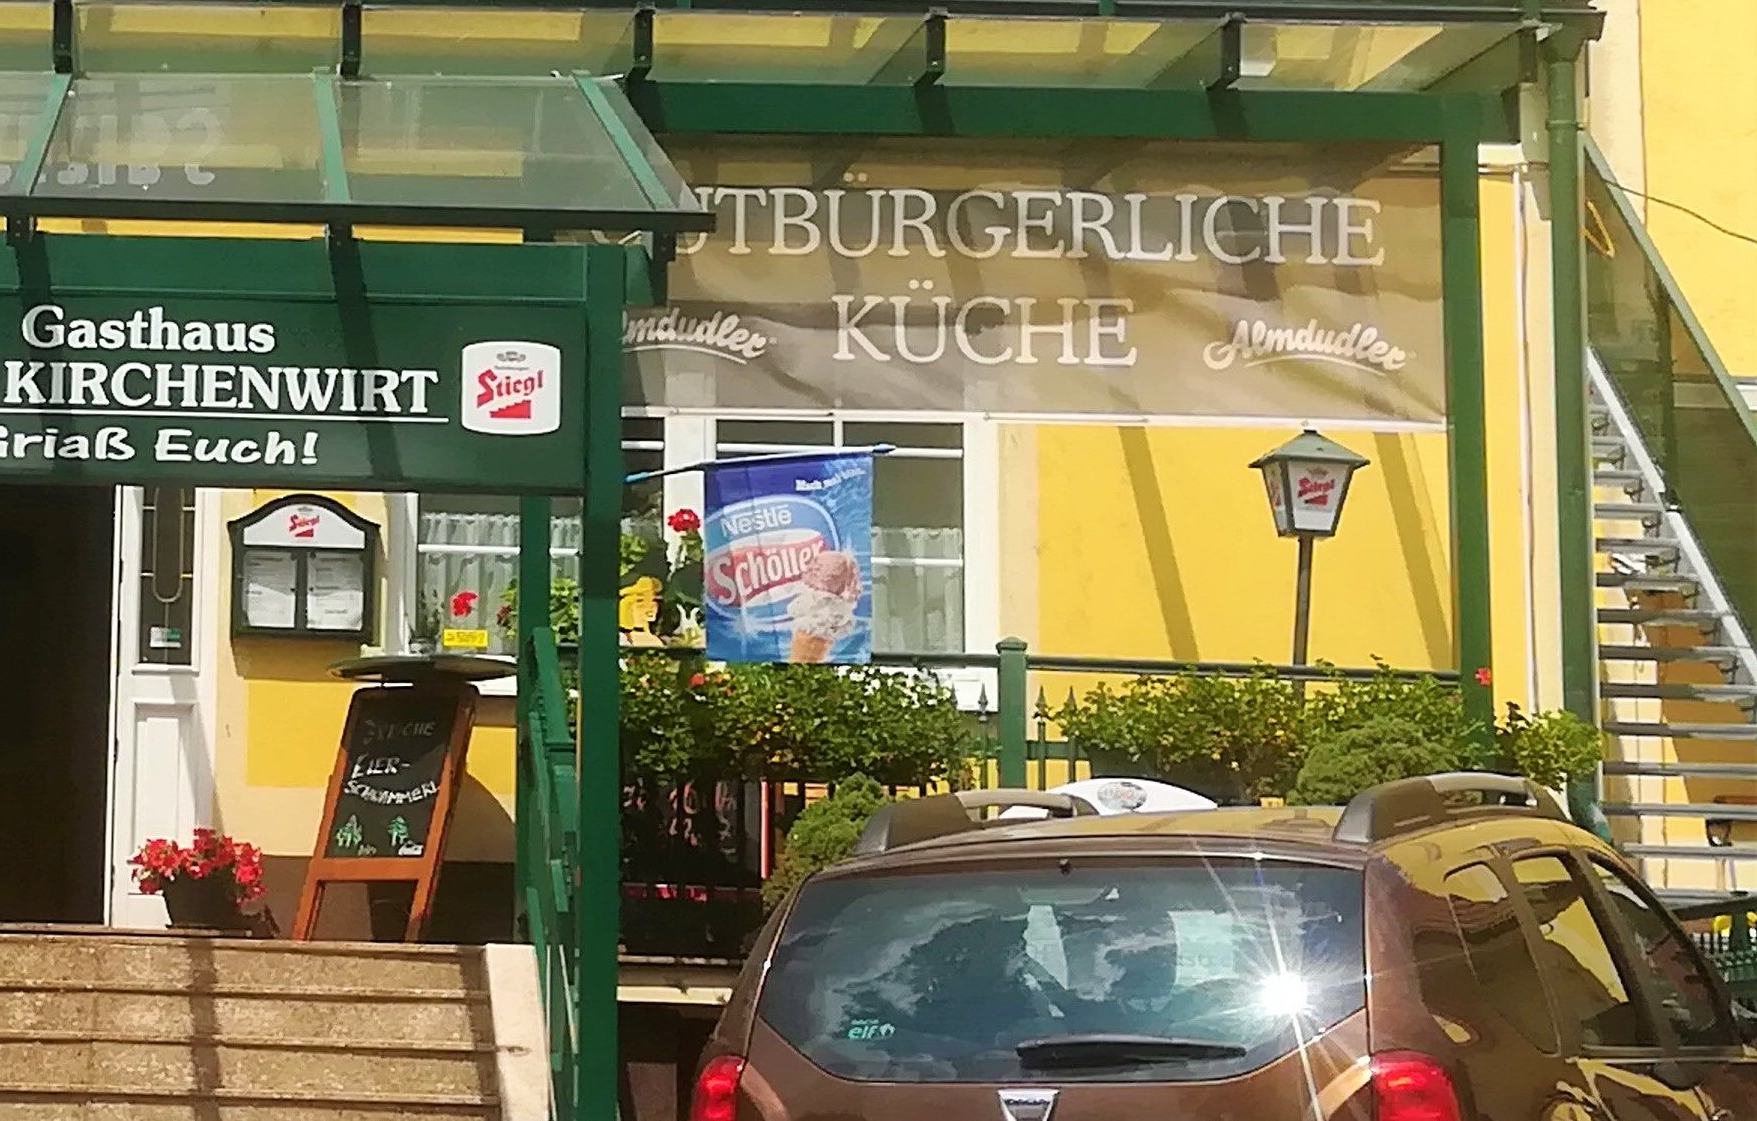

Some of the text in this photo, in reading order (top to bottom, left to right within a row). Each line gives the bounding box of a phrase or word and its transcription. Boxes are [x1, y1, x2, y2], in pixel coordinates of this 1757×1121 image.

[21, 305, 274, 354] Gasthaus
[622, 308, 768, 359] mdudler
[832, 279, 1137, 367] KÜCHE
[1203, 318, 1407, 374] Almdudler
[4, 359, 439, 414] KIRCHENWIRT
[477, 369, 545, 409] Stiegl
[154, 430, 320, 467] Euch!
[711, 539, 828, 606] Schöller
